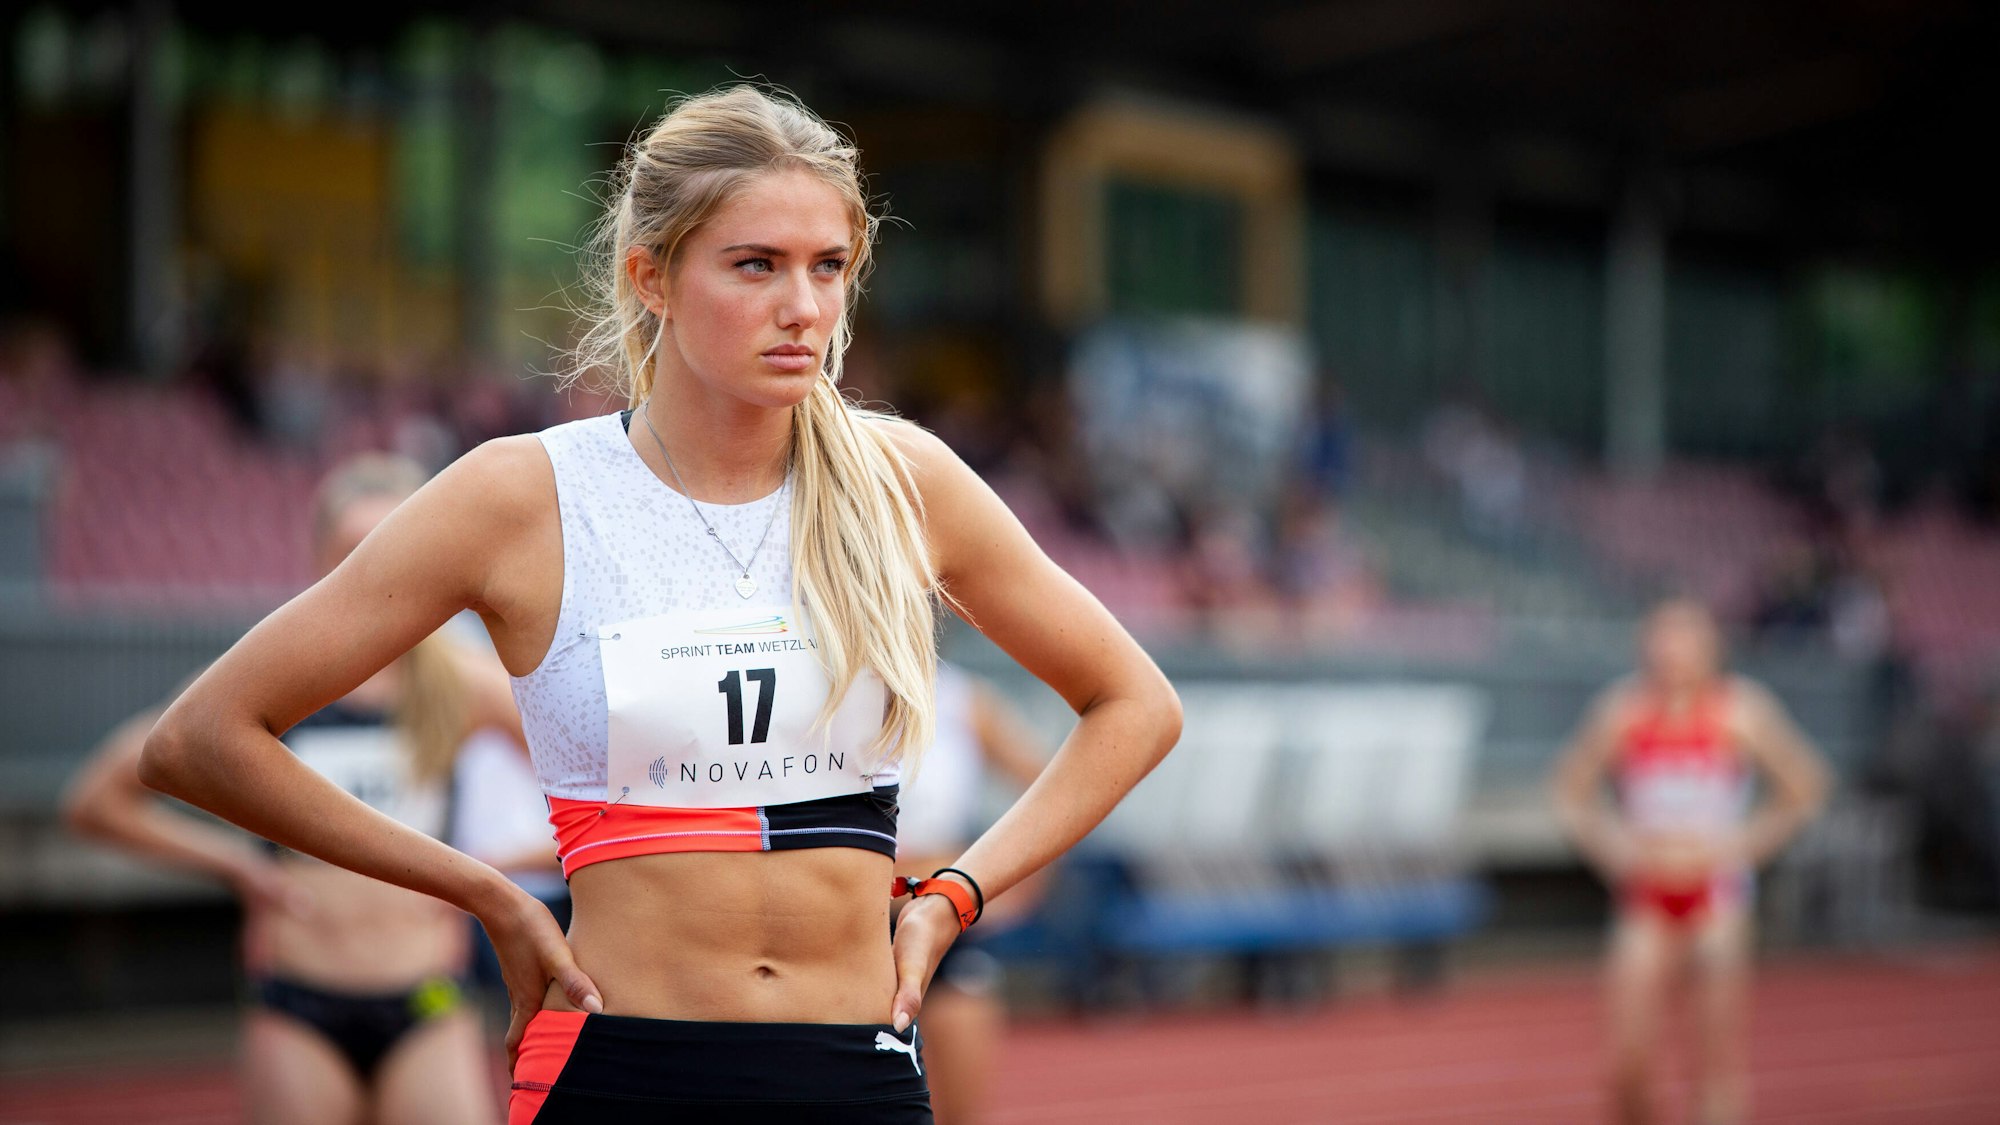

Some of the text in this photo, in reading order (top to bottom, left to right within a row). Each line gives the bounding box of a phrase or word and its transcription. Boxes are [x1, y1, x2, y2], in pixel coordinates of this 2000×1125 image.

[661, 645, 712, 660] SPRINT
[715, 642, 755, 656] TEAM
[717, 667, 777, 746] 17
[680, 751, 845, 783] NOVAFON
